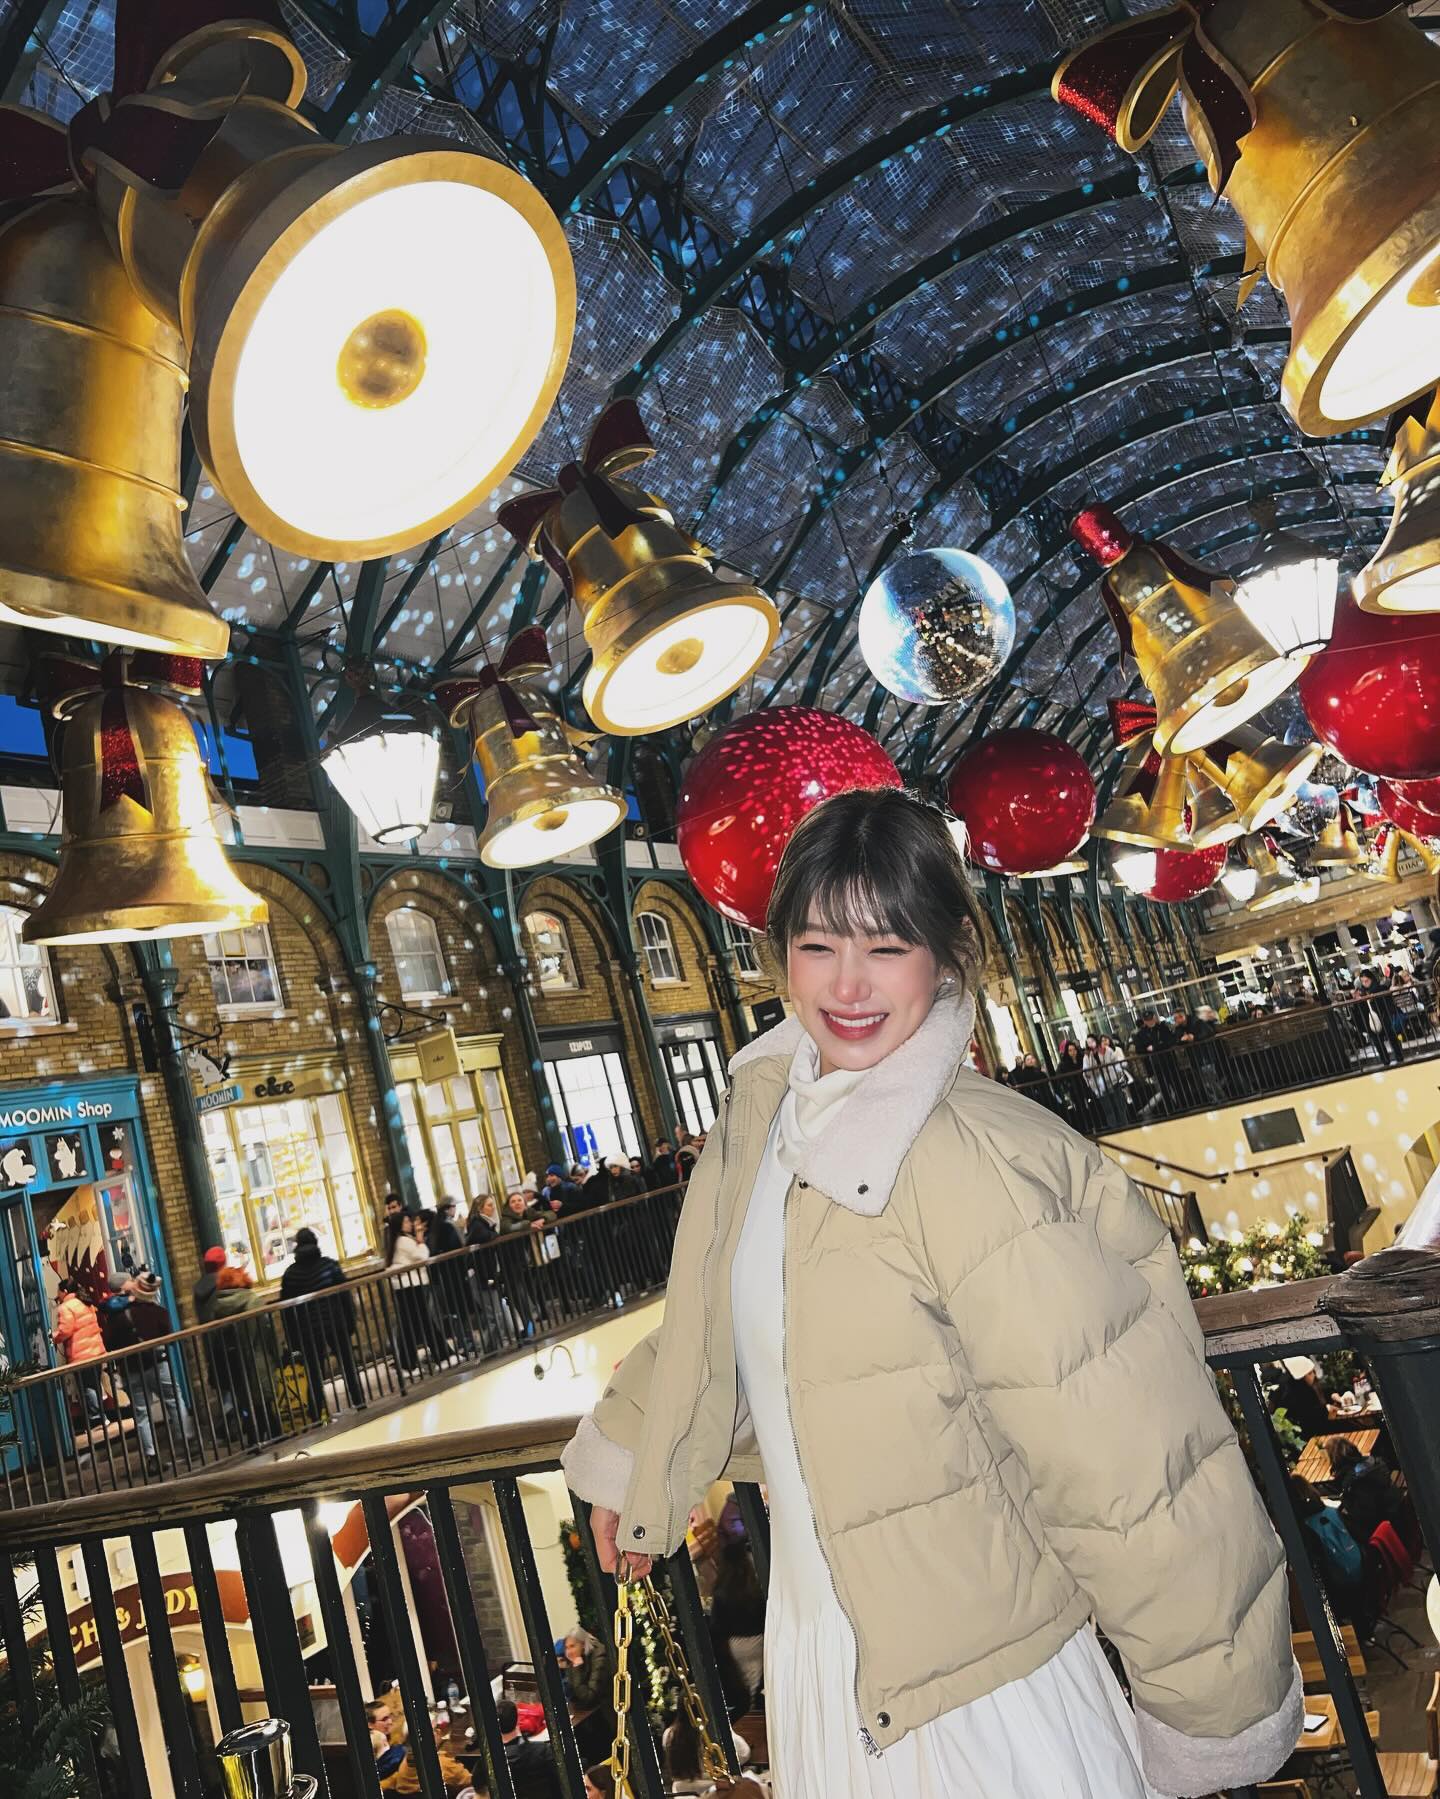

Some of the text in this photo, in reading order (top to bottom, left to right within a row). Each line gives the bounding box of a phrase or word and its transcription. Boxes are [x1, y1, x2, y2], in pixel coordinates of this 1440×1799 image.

[0, 1100, 112, 1129] MOOMIN Shop
[135, 1584, 199, 1631] JDY
